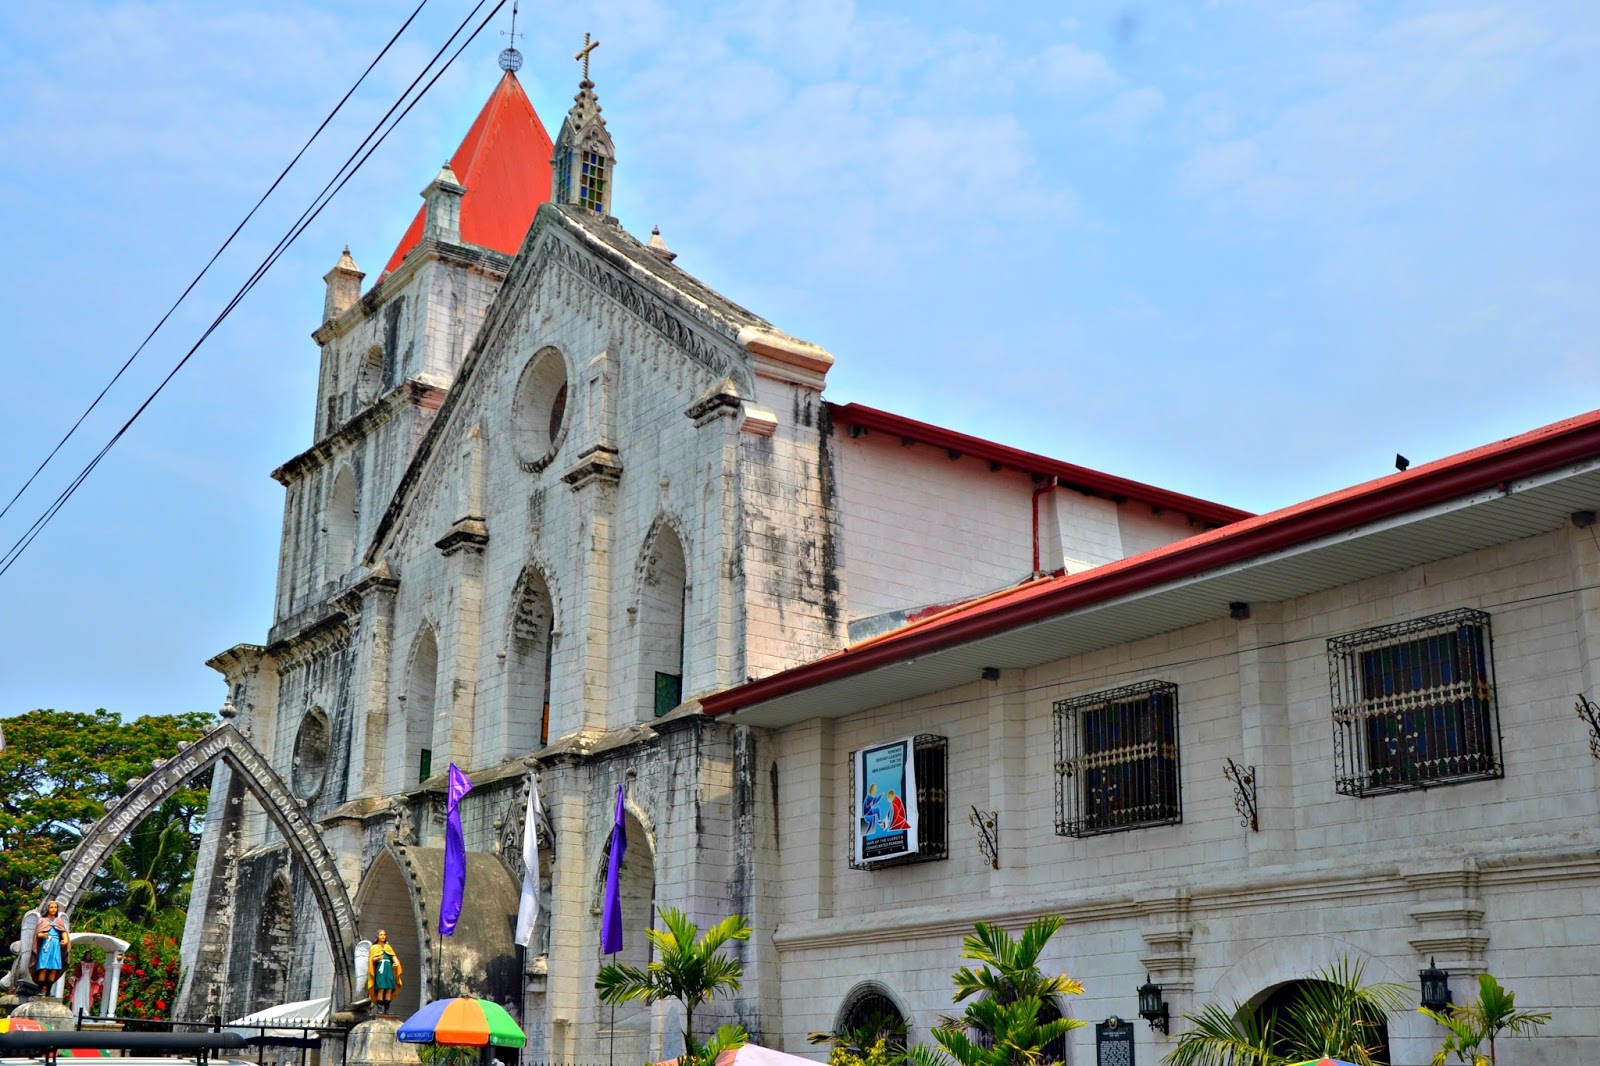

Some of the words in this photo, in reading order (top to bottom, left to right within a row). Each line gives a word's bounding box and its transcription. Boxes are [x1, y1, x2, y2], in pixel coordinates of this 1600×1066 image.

[55, 839, 108, 907] DIOCESAN
[107, 794, 150, 837] SHRINE
[151, 776, 169, 795] OF
[172, 756, 199, 778] THE
[201, 735, 271, 788] IMMACULATE
[270, 788, 326, 868] CONCEPTION
[321, 870, 337, 887] OF
[332, 897, 352, 931] MARY
